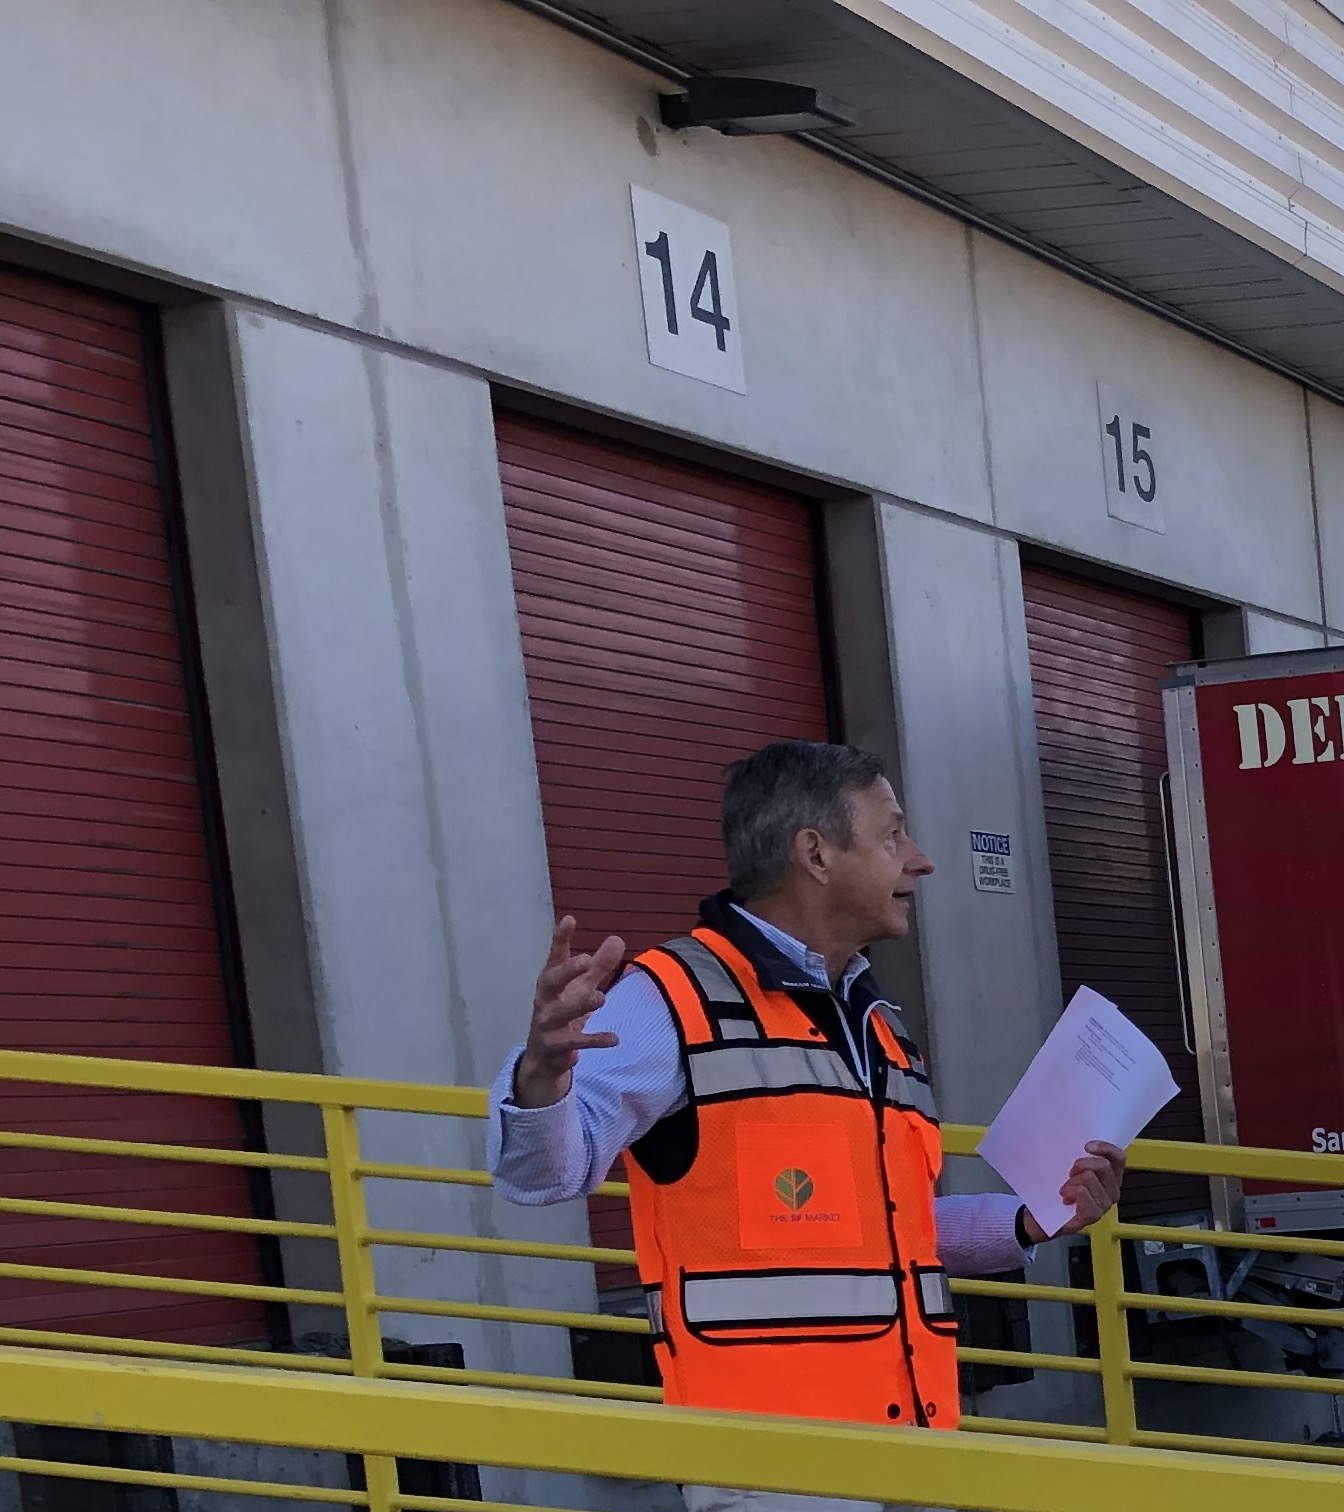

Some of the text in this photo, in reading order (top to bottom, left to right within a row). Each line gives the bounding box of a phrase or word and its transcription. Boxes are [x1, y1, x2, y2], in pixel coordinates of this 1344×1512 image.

[645, 230, 731, 352] 14
[1105, 414, 1157, 503] 15
[972, 833, 1009, 854] NOTICE
